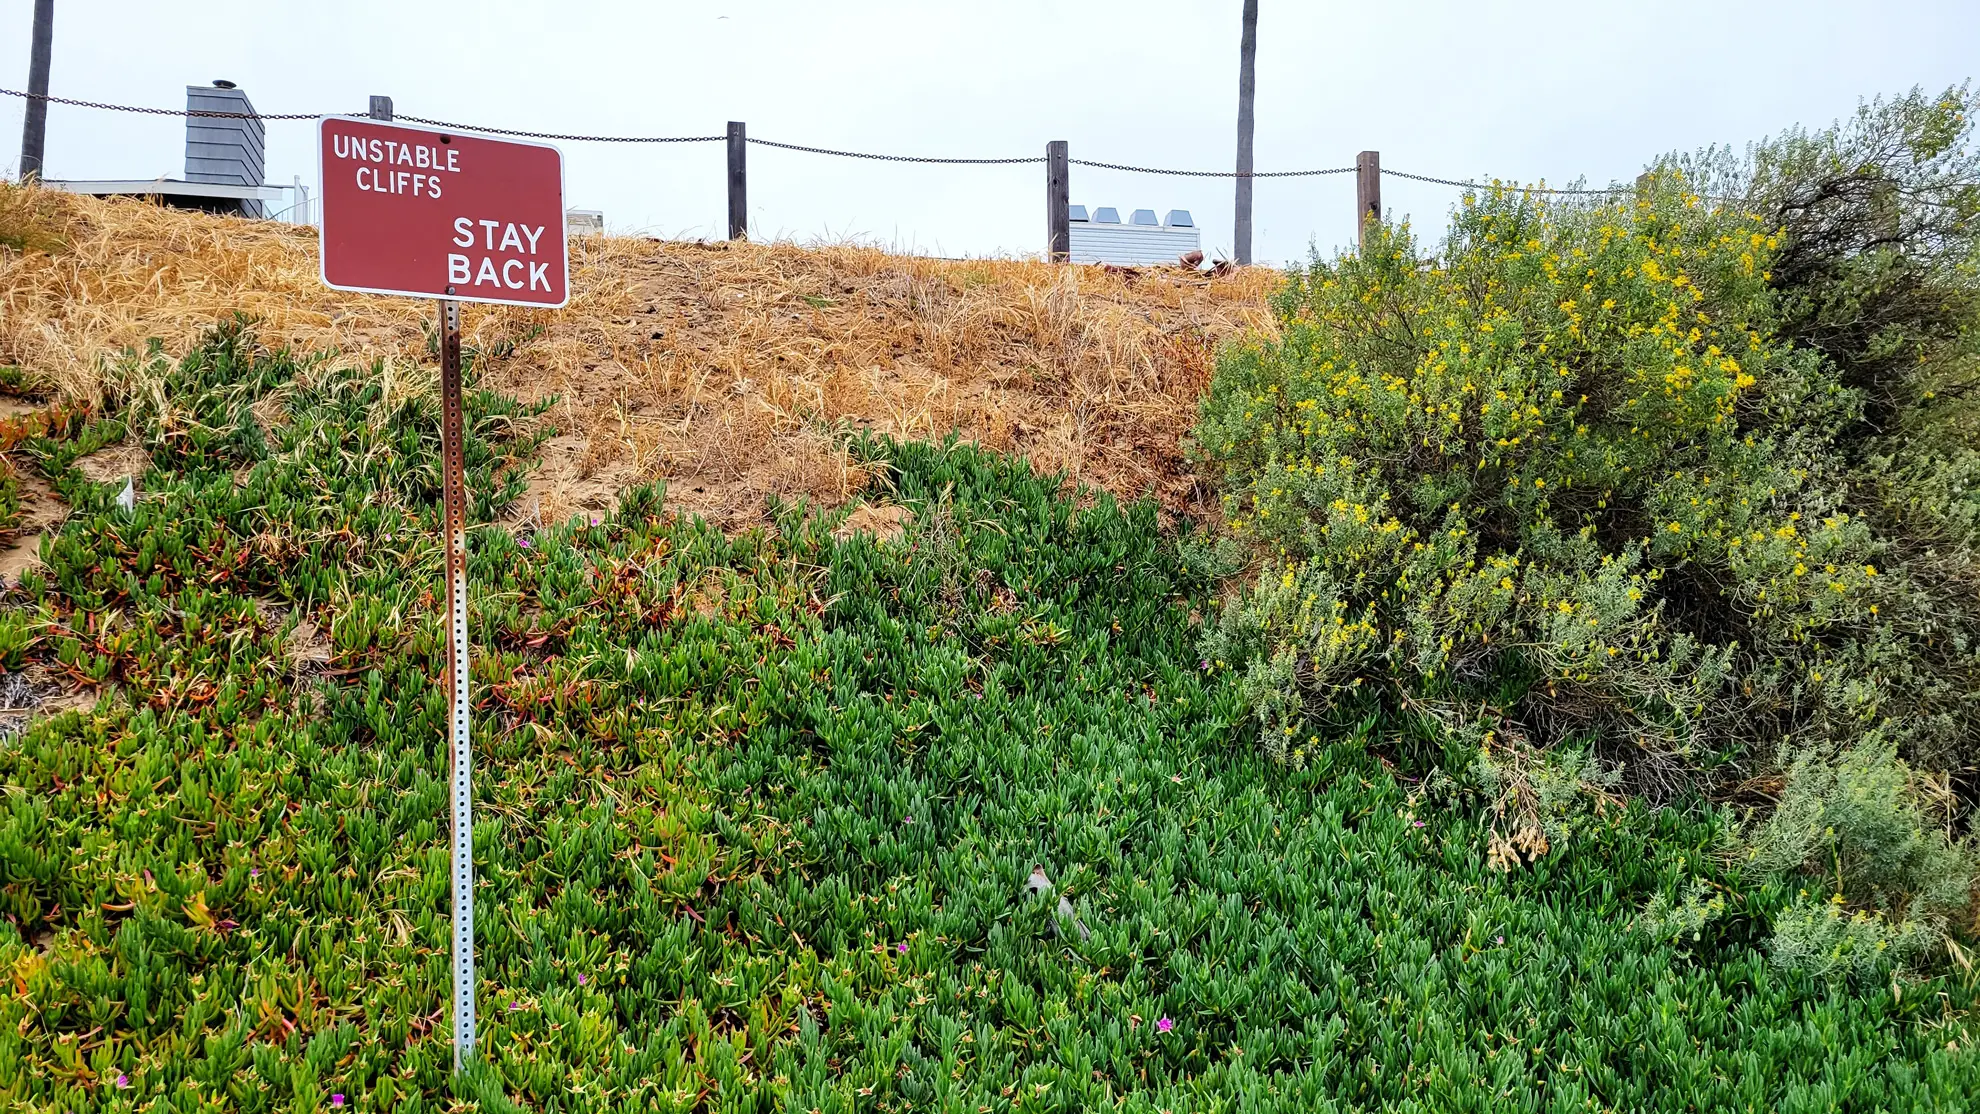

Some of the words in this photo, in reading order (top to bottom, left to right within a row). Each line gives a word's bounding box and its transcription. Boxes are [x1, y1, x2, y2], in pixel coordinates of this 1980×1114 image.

[333, 135, 461, 172] UNSTABLE
[356, 167, 442, 198] CLIFFS
[453, 217, 545, 254] STAY
[448, 254, 552, 292] BACK
